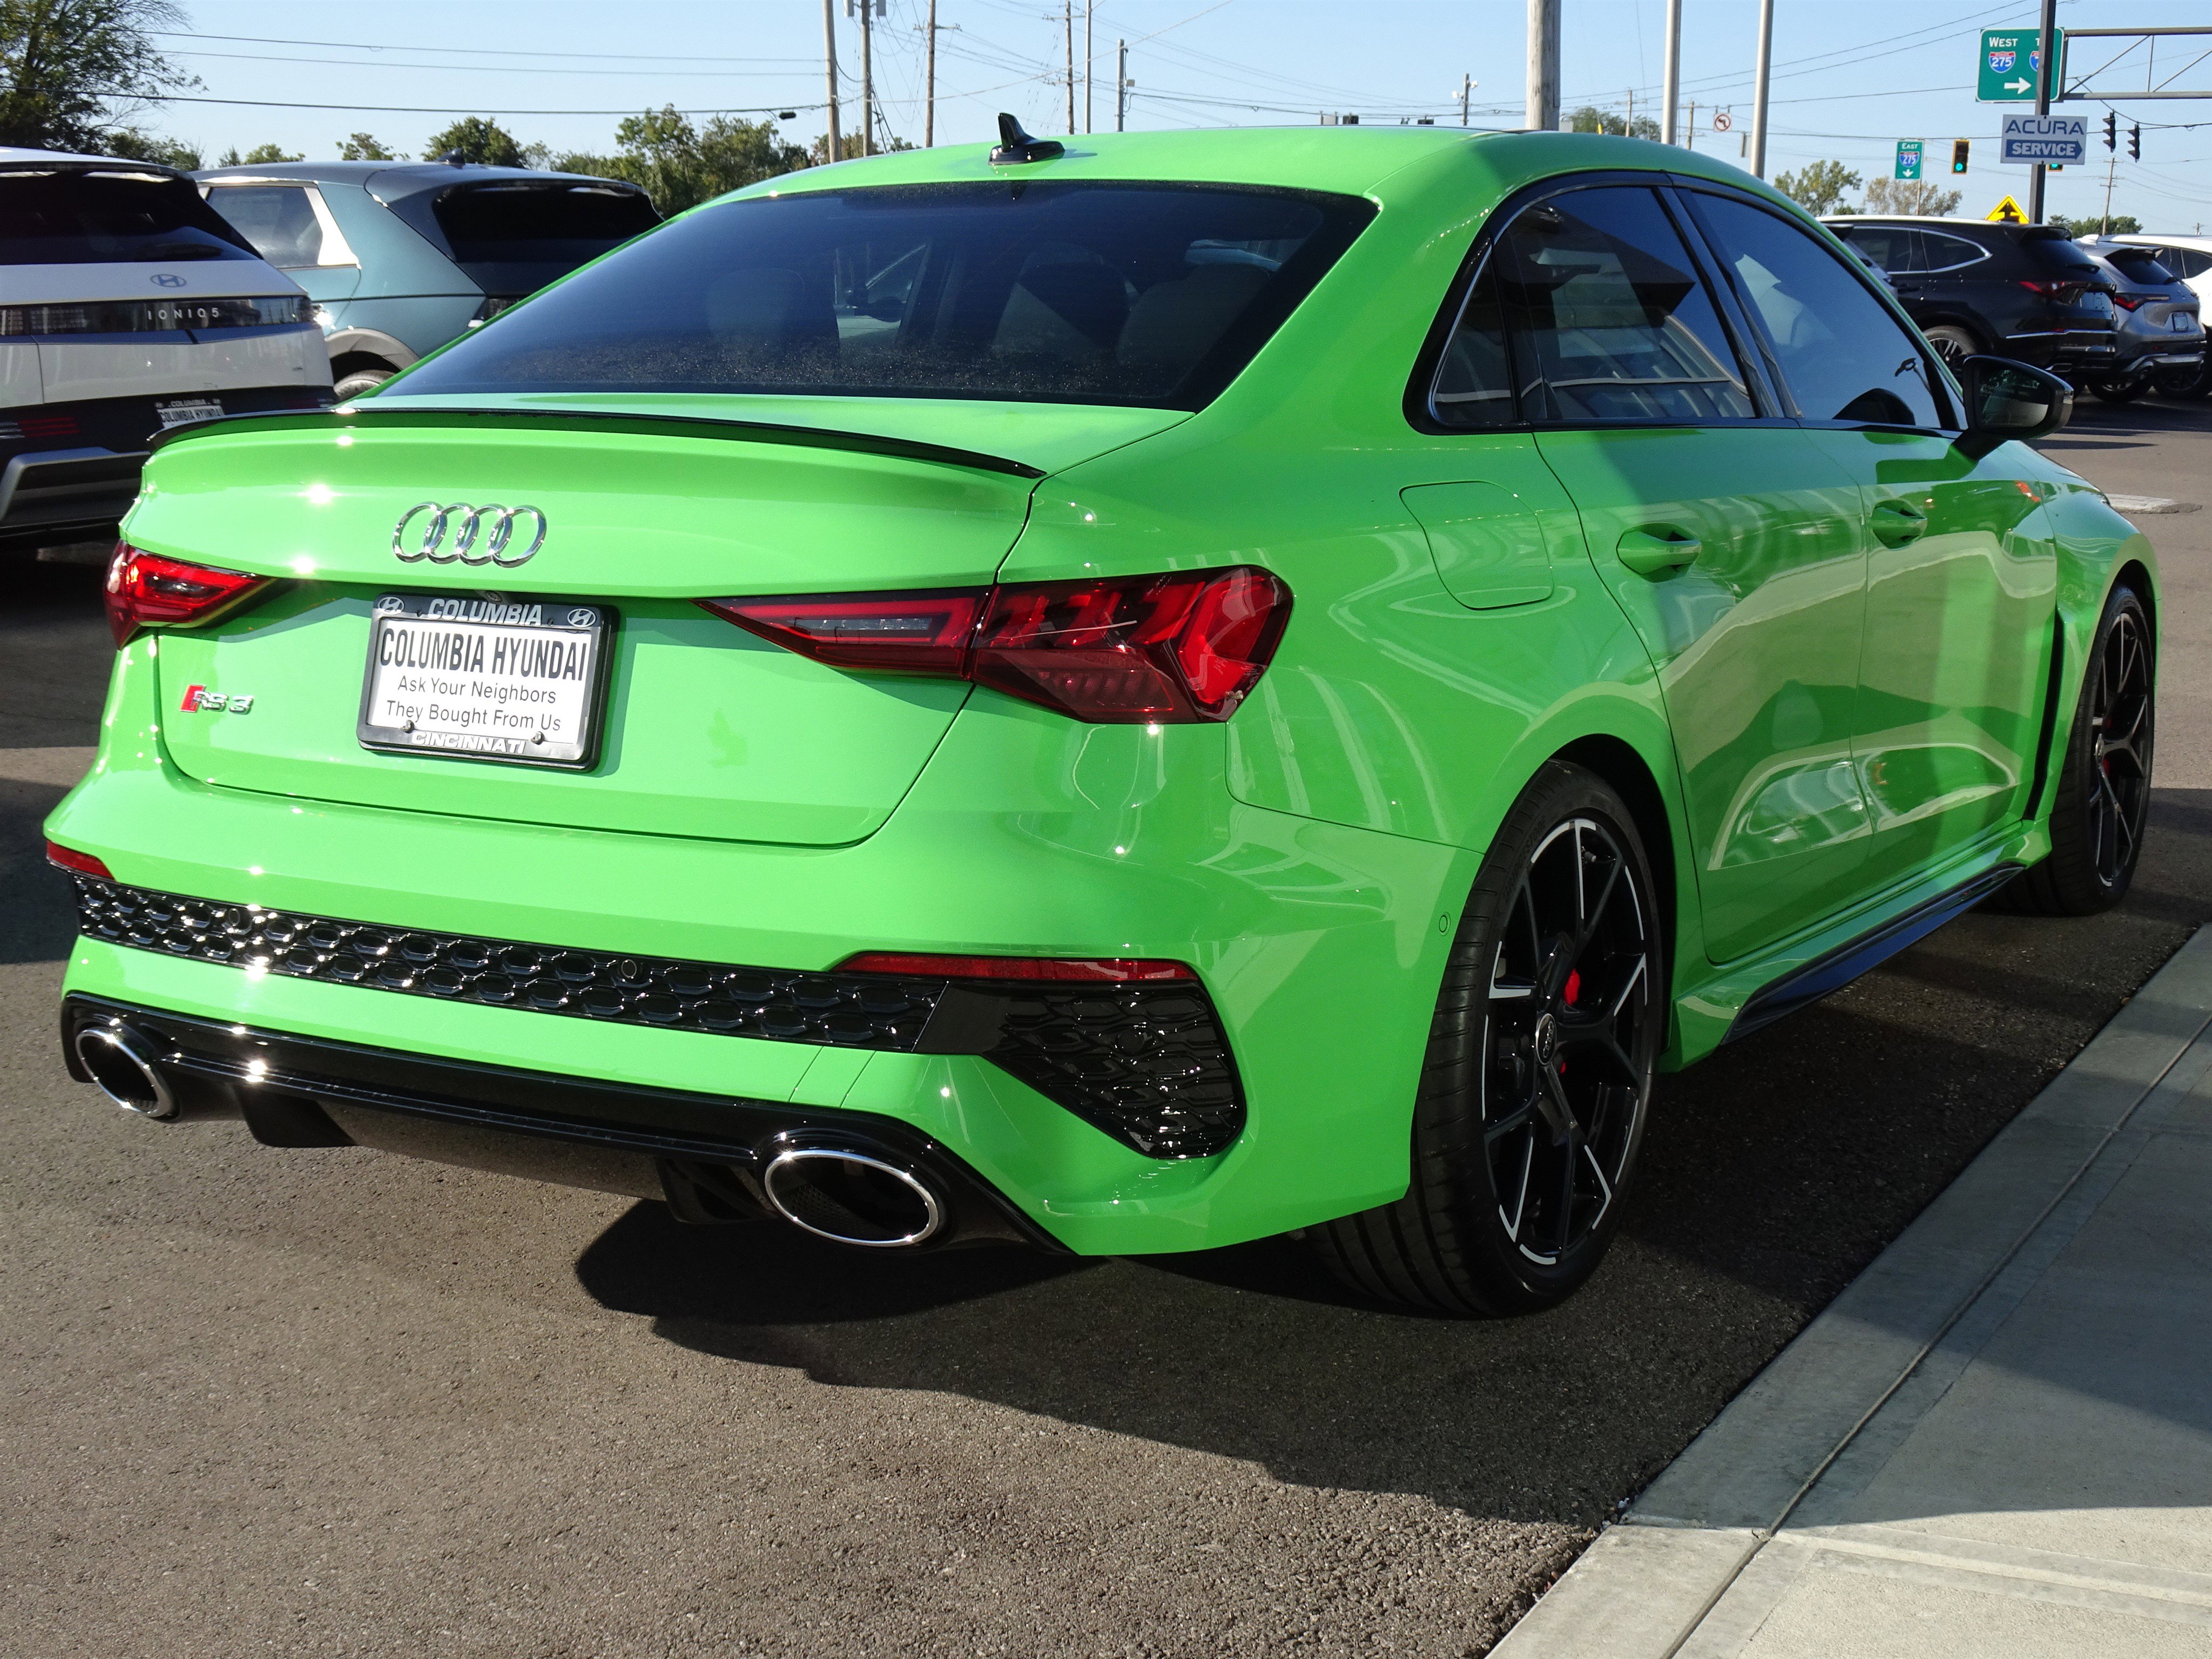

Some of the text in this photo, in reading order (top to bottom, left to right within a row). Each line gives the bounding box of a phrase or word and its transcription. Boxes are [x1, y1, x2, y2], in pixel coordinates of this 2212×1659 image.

[1988, 37, 2018, 47] WEST
[1992, 57, 2012, 67] 275
[2005, 119, 2085, 135] ACURA
[2011, 142, 2076, 156] SERVICE
[1903, 154, 1916, 164] 275
[211, 307, 219, 318] 5
[428, 598, 542, 626] COLUMBIA
[381, 628, 587, 681] COLUMBIA HYUNDAI
[397, 675, 556, 704] Ask Your Neighbors
[387, 700, 561, 731] They Bought From Us
[412, 731, 526, 754] CINCINNATI
